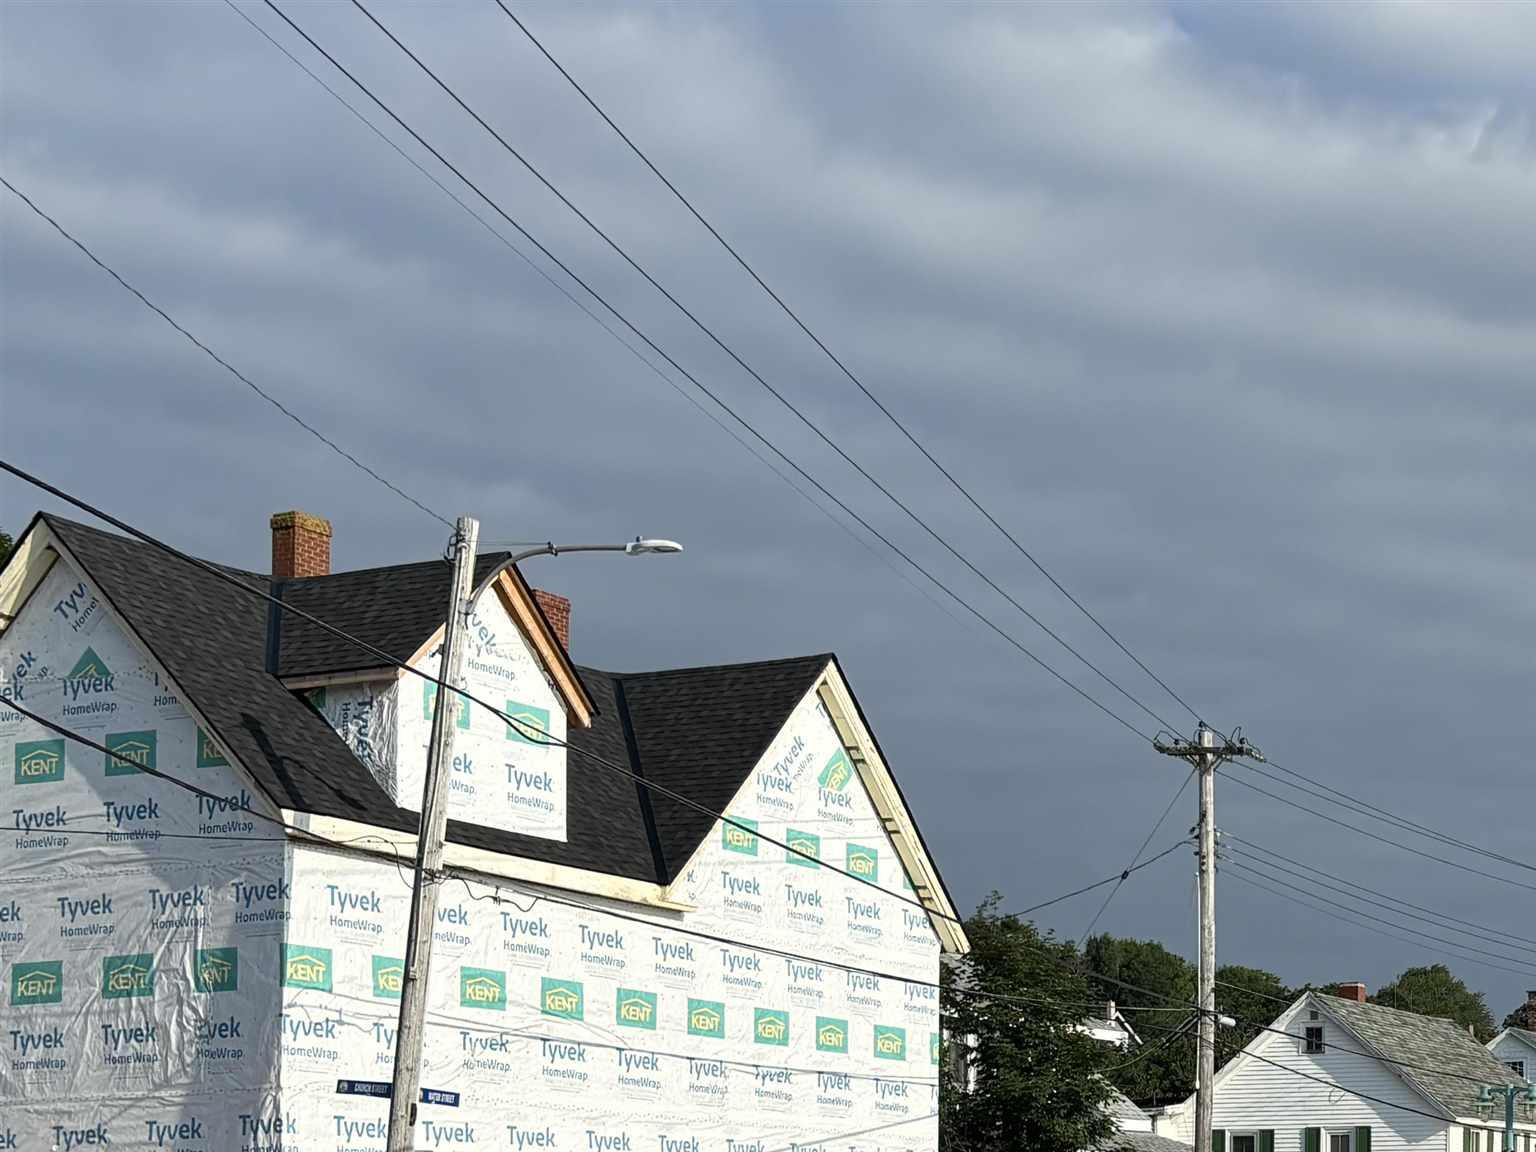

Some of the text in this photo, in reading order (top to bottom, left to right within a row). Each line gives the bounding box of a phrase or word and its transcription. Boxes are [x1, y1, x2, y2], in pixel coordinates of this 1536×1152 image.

[468, 658, 516, 681] HomeWrap
[59, 675, 114, 701] Tyvek
[62, 702, 117, 716] HomeWrap
[111, 748, 150, 767] KENT
[203, 741, 222, 759] KE
[774, 736, 805, 776] Tyvek
[21, 757, 59, 776] KENT
[505, 764, 553, 792] Tyvek
[757, 772, 792, 794] Tyvek
[196, 790, 251, 820] Tyvek
[507, 792, 554, 812] HomeWrap
[13, 806, 67, 834] Tyvek
[103, 798, 159, 828] Tyvek
[106, 829, 161, 842] HomeWrap
[199, 821, 253, 834] HomeWrap
[15, 836, 68, 849] HomeWrap
[727, 831, 753, 849] KENT
[850, 859, 874, 875] KENT
[232, 879, 289, 903] Tyvek
[721, 871, 760, 896] Tyvek
[149, 885, 204, 914] Tyvek
[327, 885, 381, 913] Tyvek
[785, 884, 821, 908] Tyvek
[57, 894, 112, 922] Tyvek
[235, 911, 291, 924] HomeWrap
[846, 897, 881, 920] Tyvek
[60, 924, 114, 937] HomeWrap
[330, 915, 383, 933] HomeWrap
[500, 912, 548, 937] Tyvek
[579, 925, 623, 950] Tyvek
[504, 940, 550, 957] HomeWrap
[652, 937, 694, 961] Tyvek
[581, 952, 625, 968] HomeWrap
[720, 949, 760, 972] Tyvek
[108, 972, 148, 991] KENT
[288, 962, 326, 983] KENT
[656, 963, 695, 979] HomeWrap
[785, 960, 822, 983] Tyvek
[846, 970, 880, 992] Tyvek
[18, 978, 56, 997] KENT
[466, 983, 500, 1002] KENT
[723, 975, 761, 989] HomeWrap
[788, 984, 823, 999] HomeWrap
[904, 983, 935, 1000] Tyvek
[546, 994, 578, 1011] KENT
[621, 1004, 652, 1022] KENT
[279, 1014, 336, 1041] Tyvek
[692, 1015, 720, 1032] KENT
[758, 1023, 784, 1040] KENT
[10, 1027, 64, 1056] Tyvek
[102, 1024, 156, 1050] Tyvek
[460, 1031, 509, 1058] Tyvek
[820, 1032, 844, 1048] KENT
[878, 1038, 901, 1054] KENT
[104, 1052, 158, 1065] HomeWrap
[283, 1045, 338, 1059] HomeWrap
[541, 1039, 586, 1063] Tyvek
[617, 1048, 658, 1072] Tyvek
[12, 1059, 66, 1070] HomeWrap
[542, 1067, 587, 1081] HomeWrap
[687, 1057, 728, 1080] Tyvek
[618, 1075, 661, 1089] HomeWrap
[817, 1072, 850, 1093] Tyvek
[874, 1078, 908, 1099] Tyvek
[146, 1118, 202, 1147] Tyvek
[239, 1112, 296, 1136] Tyvek
[333, 1116, 387, 1142] Tyvek
[422, 1121, 474, 1147] Tyvek
[53, 1125, 108, 1152] Tyvek
[507, 1126, 555, 1151] Tyvek
